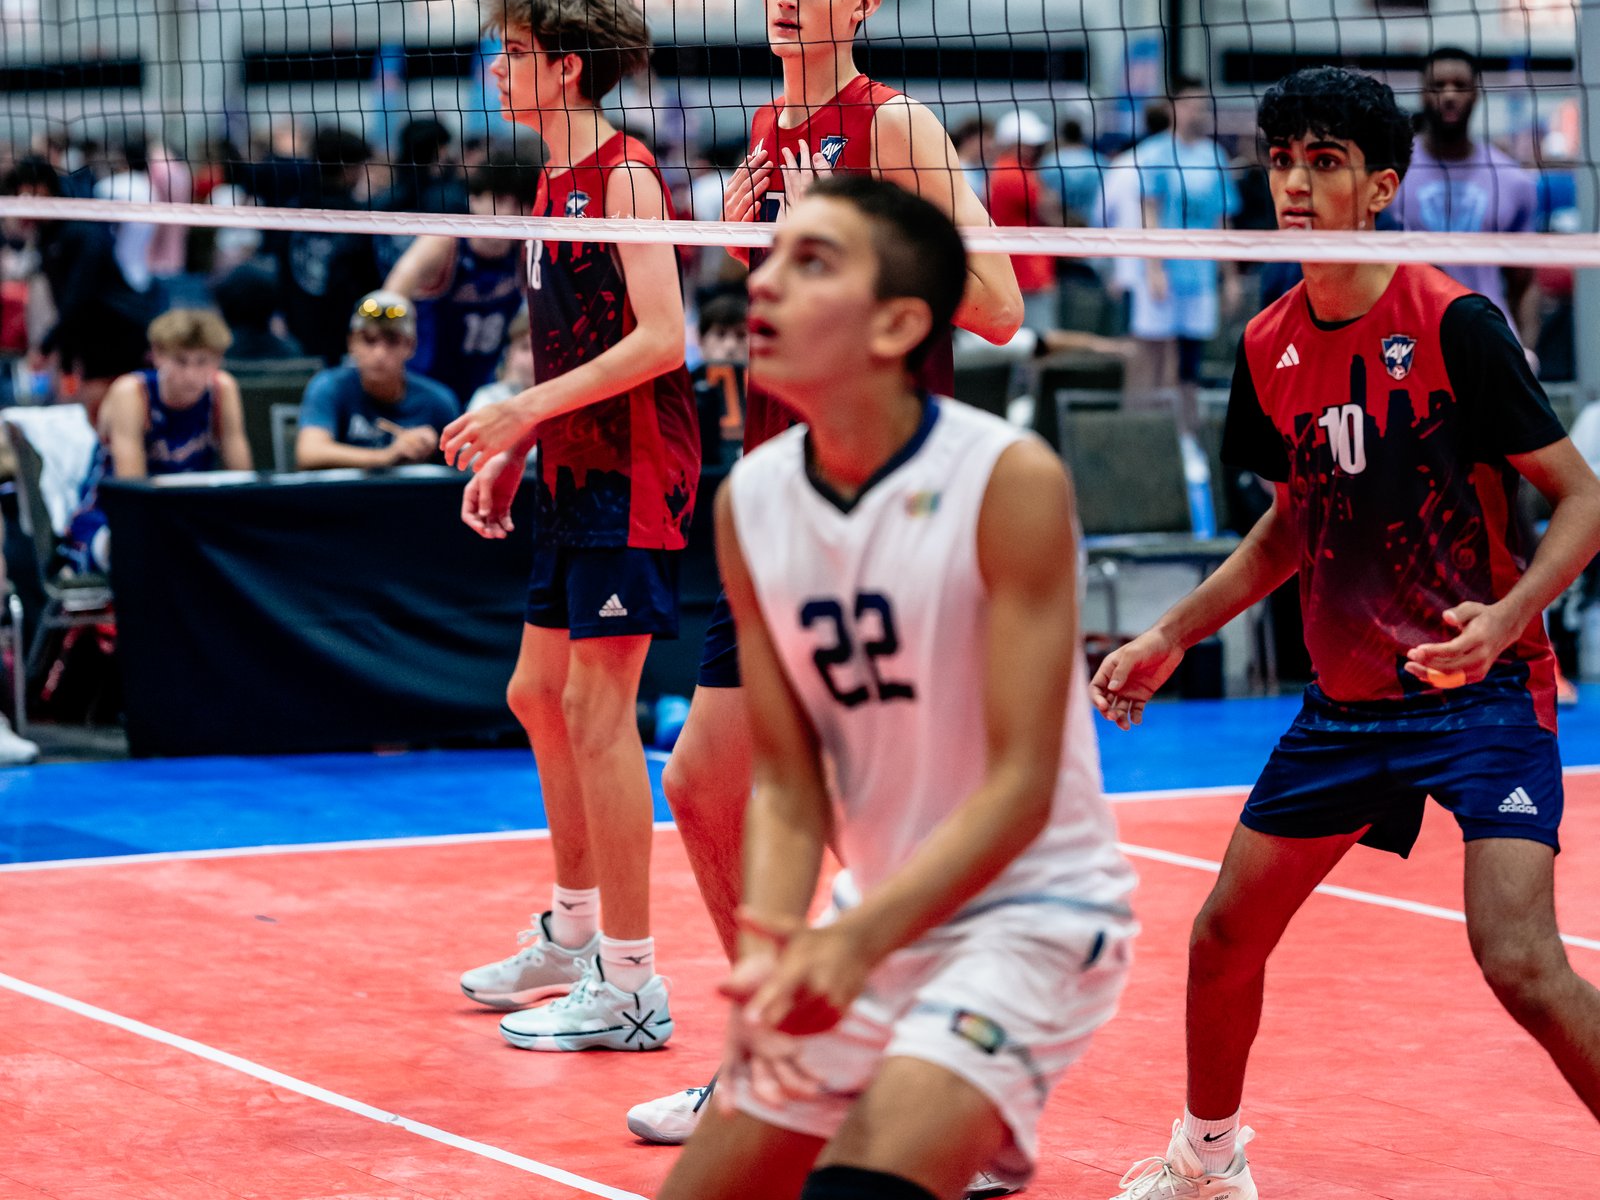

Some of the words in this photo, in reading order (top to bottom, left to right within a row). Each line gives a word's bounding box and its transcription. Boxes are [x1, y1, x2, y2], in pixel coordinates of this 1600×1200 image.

[1318, 403, 1367, 475] 10
[799, 592, 915, 708] 22
[1498, 804, 1538, 815] adidas
